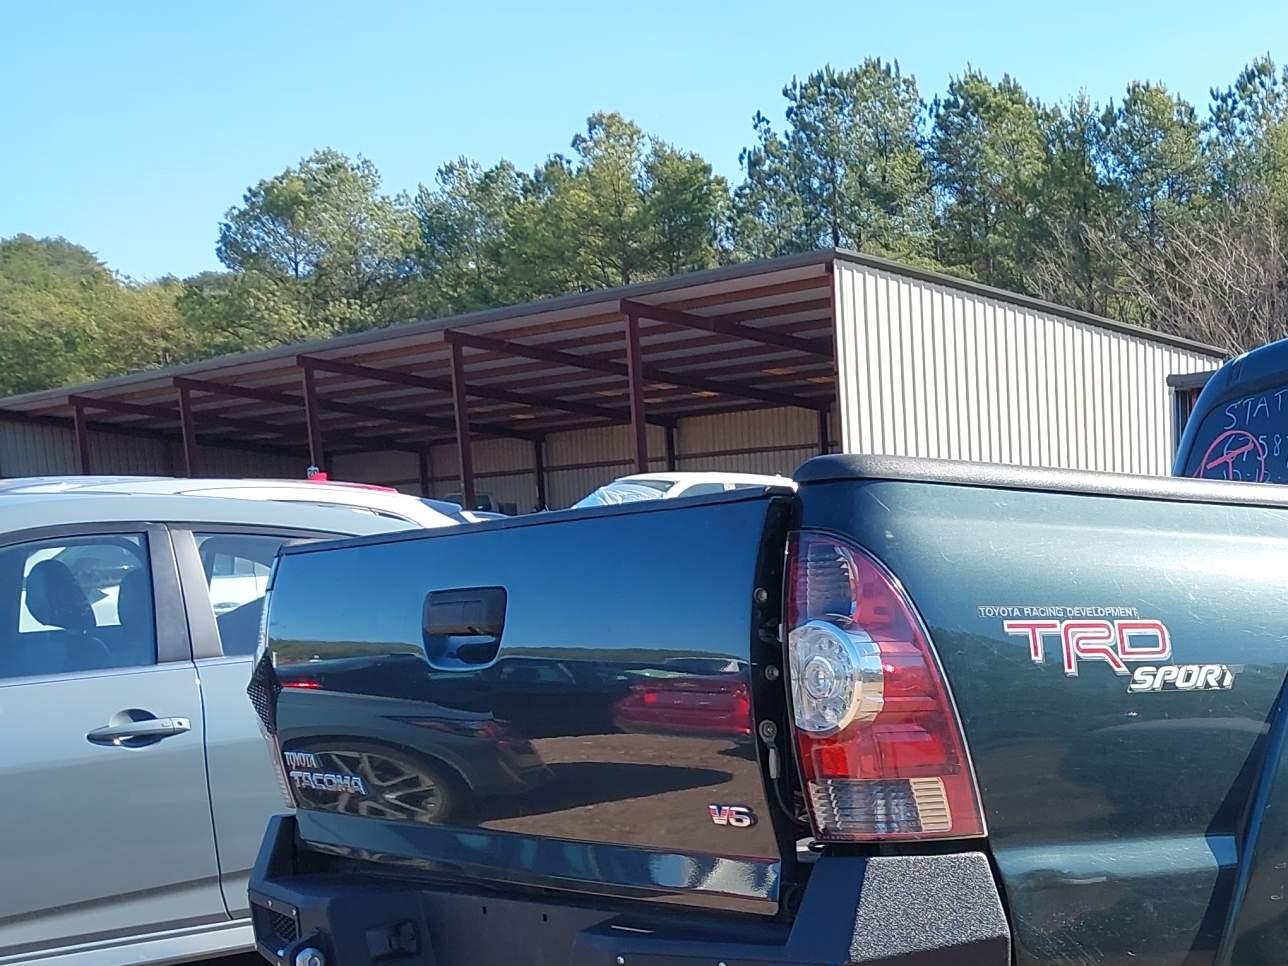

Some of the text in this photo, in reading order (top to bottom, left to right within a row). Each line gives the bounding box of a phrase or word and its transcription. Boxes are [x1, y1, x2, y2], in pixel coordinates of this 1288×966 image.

[978, 606, 1139, 618] TOYOTA RACING DEVELOPMENT
[1003, 619, 1171, 677] TRD
[284, 751, 319, 769] TOYOTA
[290, 771, 367, 796] TACOMA
[707, 804, 755, 828] V6
